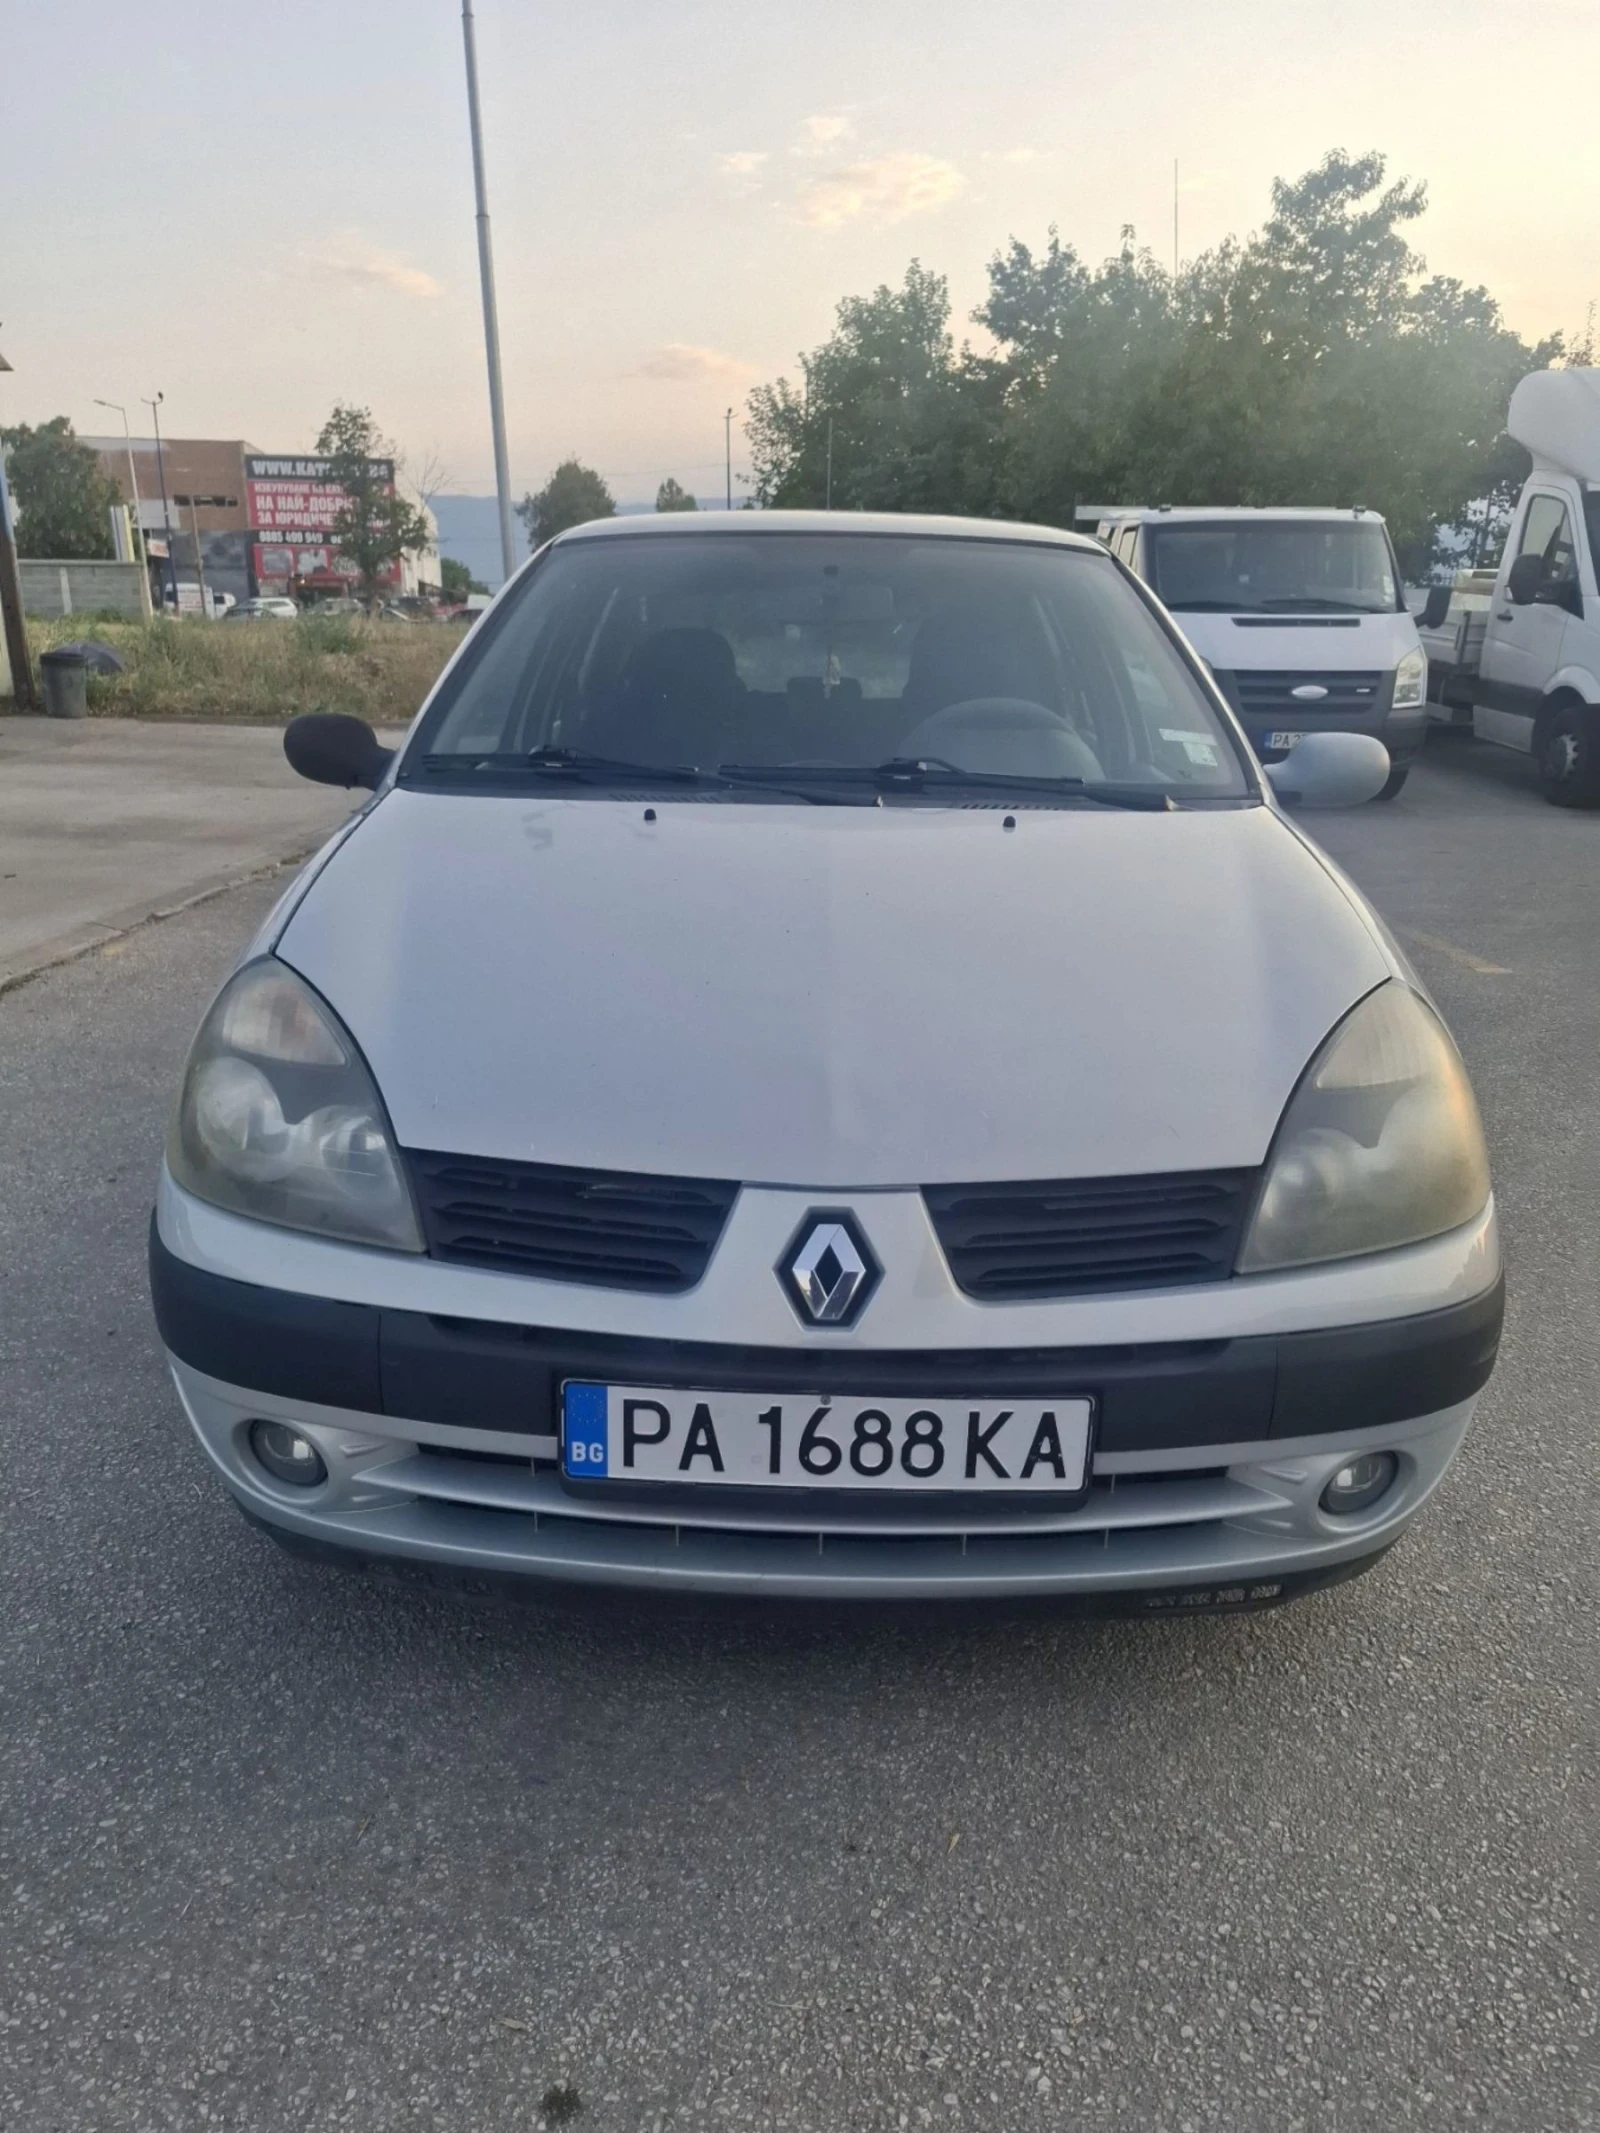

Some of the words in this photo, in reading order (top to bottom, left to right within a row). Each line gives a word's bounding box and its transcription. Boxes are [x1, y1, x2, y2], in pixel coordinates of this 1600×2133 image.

[256, 495, 274, 510] НА
[257, 511, 272, 525] ЗА
[1273, 734, 1290, 747] PA
[623, 1398, 725, 1472] PA
[758, 1405, 945, 1478] 1688
[964, 1411, 1066, 1479] KA
[571, 1441, 604, 1463] BG
